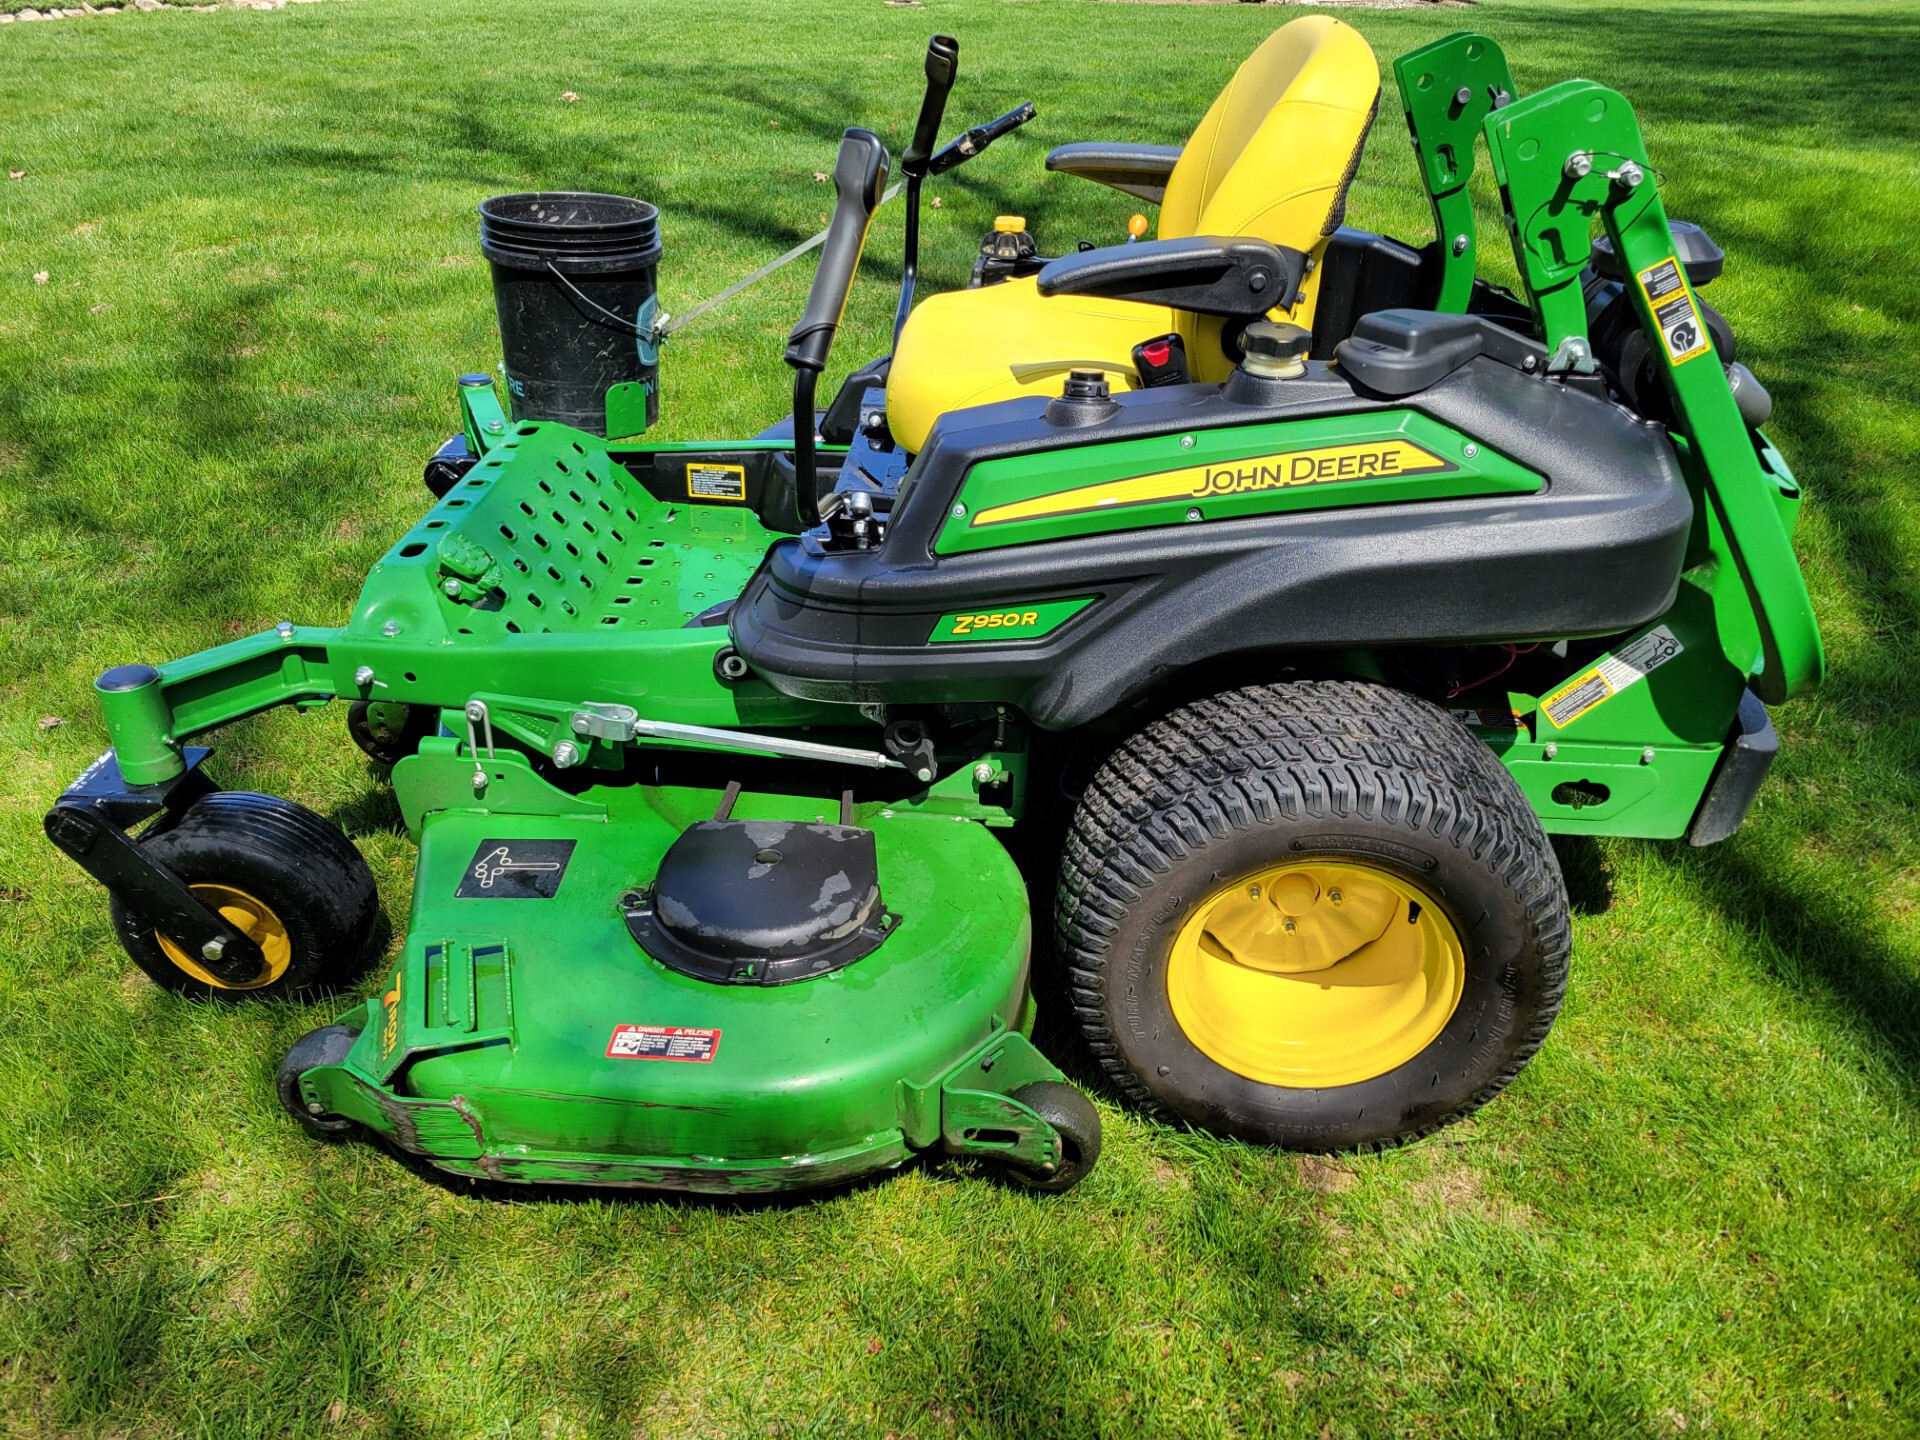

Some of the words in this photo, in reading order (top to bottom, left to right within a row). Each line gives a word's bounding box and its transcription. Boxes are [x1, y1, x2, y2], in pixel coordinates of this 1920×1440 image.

[1192, 463, 1282, 494] JOHN
[1290, 450, 1401, 485] DEERE
[951, 611, 1039, 635] Z950R
